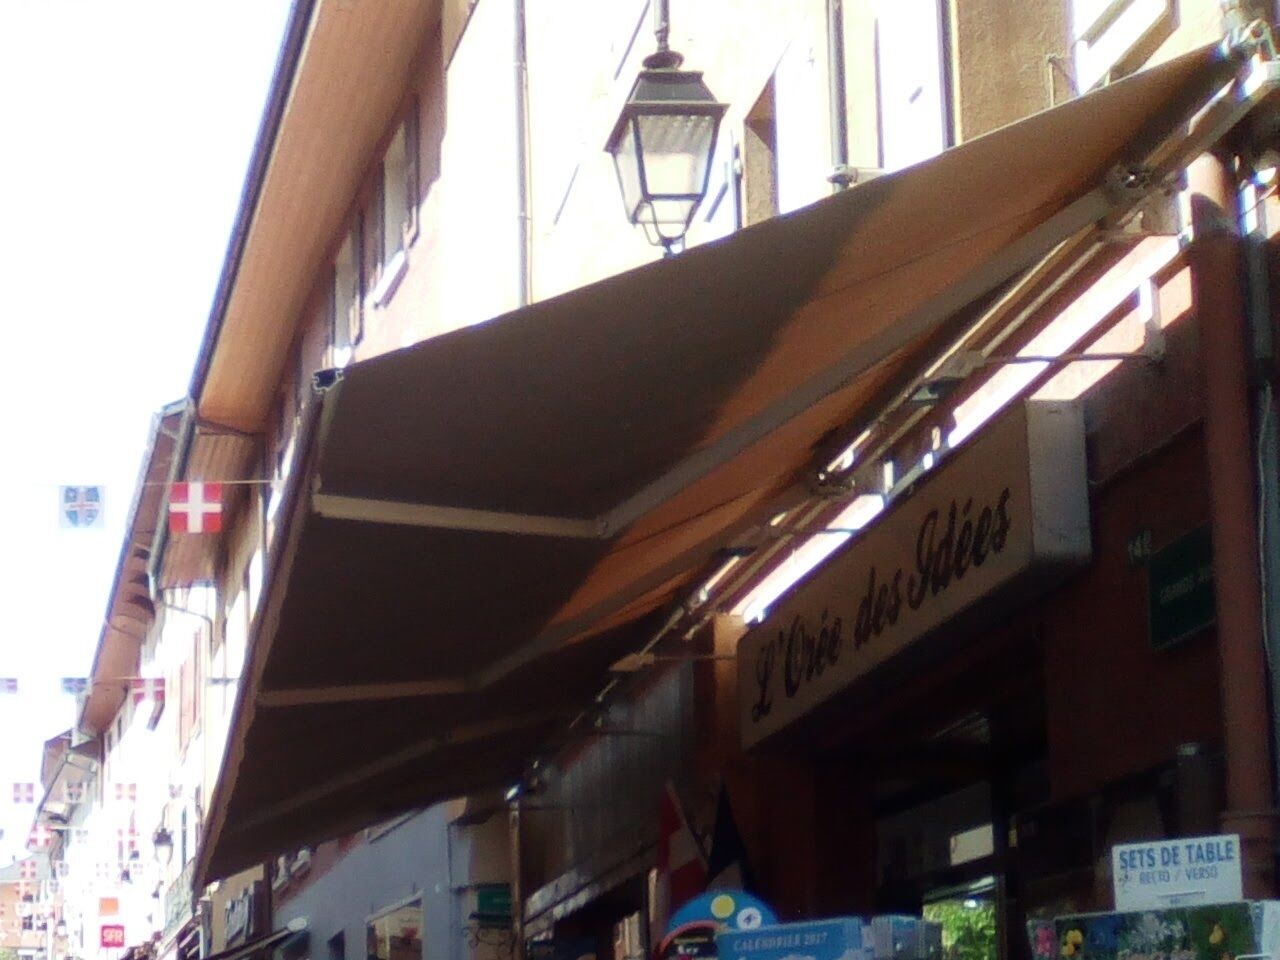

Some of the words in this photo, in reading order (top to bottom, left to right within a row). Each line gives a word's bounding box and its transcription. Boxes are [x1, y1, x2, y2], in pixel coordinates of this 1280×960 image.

[854, 565, 901, 649] des
[1119, 847, 1155, 869] SETS
[1161, 845, 1180, 866] DE
[1185, 841, 1234, 862] TABLE
[1185, 864, 1218, 881] VERSO
[102, 928, 123, 944] SFR
